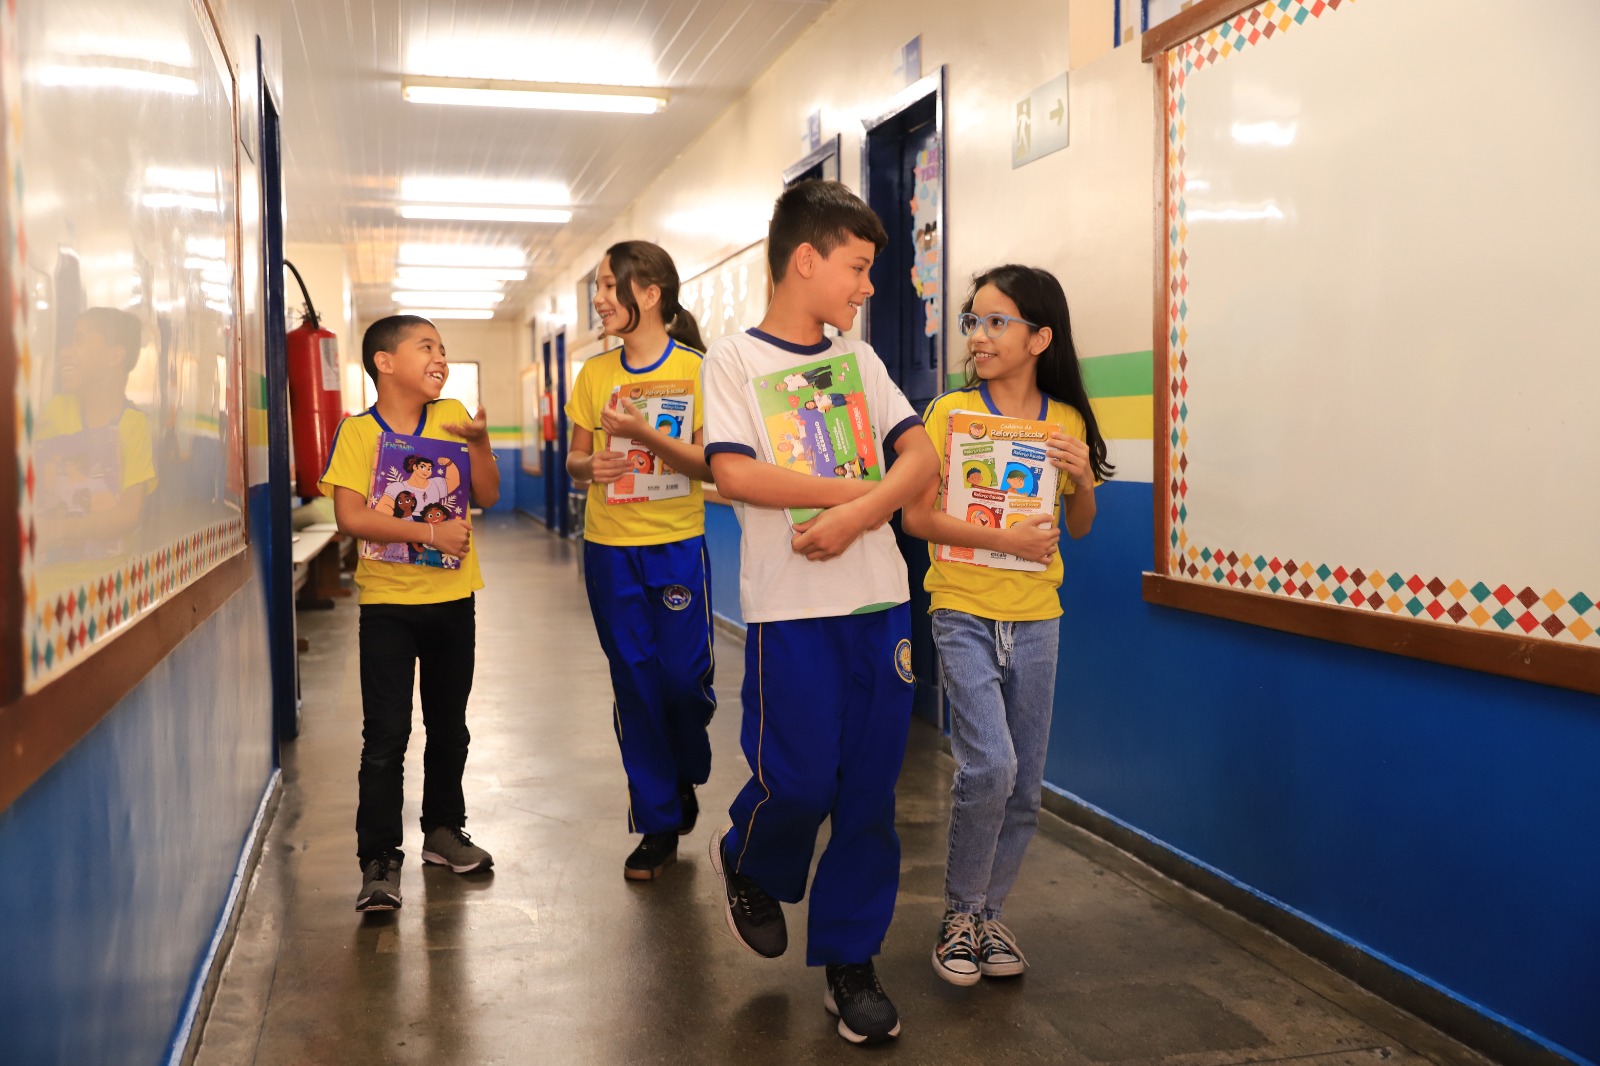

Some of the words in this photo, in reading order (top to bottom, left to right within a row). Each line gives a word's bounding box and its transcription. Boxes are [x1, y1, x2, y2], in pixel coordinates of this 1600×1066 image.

[814, 421, 827, 452] DESENHO
[990, 429, 1019, 439] Reforço
[1019, 430, 1045, 438] Escolar
[823, 452, 830, 463] DE
[1012, 449, 1030, 459] Reforço
[973, 491, 990, 499] Reforço
